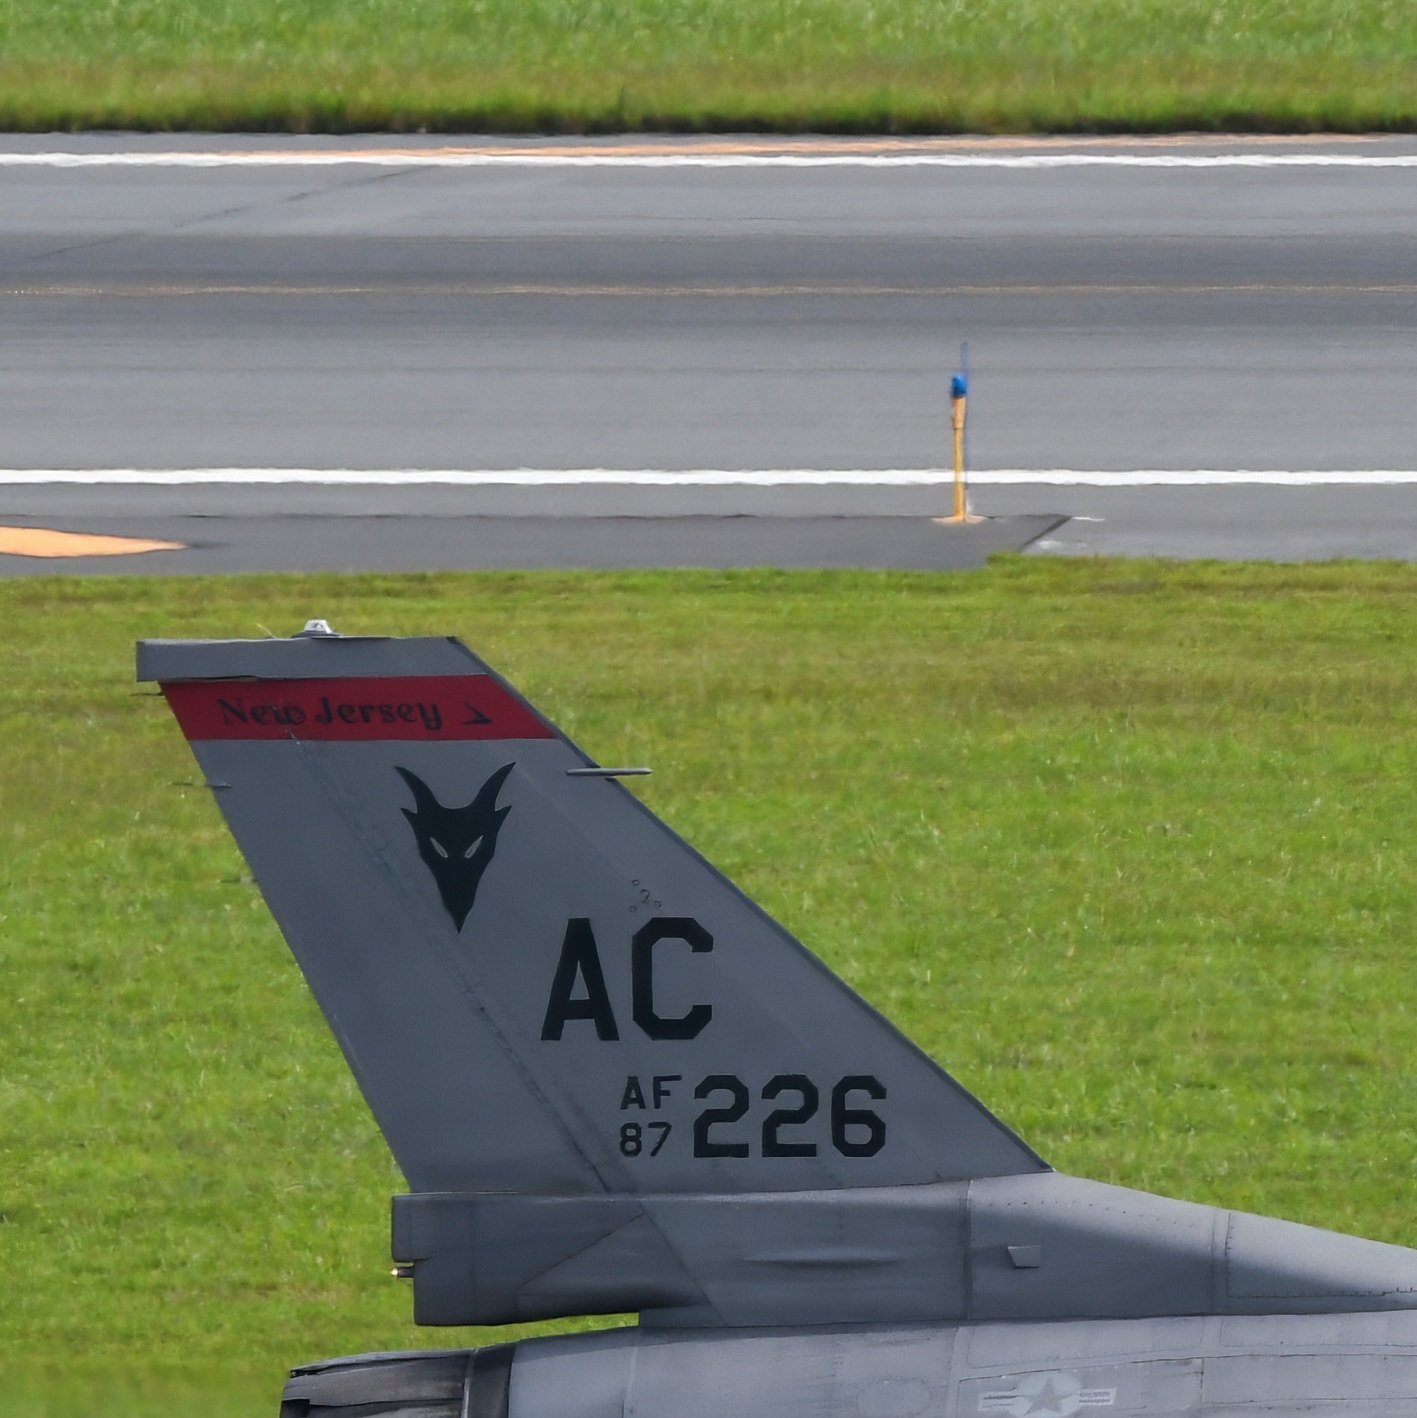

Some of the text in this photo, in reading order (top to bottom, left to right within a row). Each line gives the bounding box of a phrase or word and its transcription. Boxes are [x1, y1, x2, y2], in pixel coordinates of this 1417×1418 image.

[216, 697, 443, 731] New Jersey
[540, 917, 714, 1041] AC
[620, 1074, 682, 1110] AF
[693, 1073, 887, 1158] 226
[619, 1121, 672, 1157] 87
